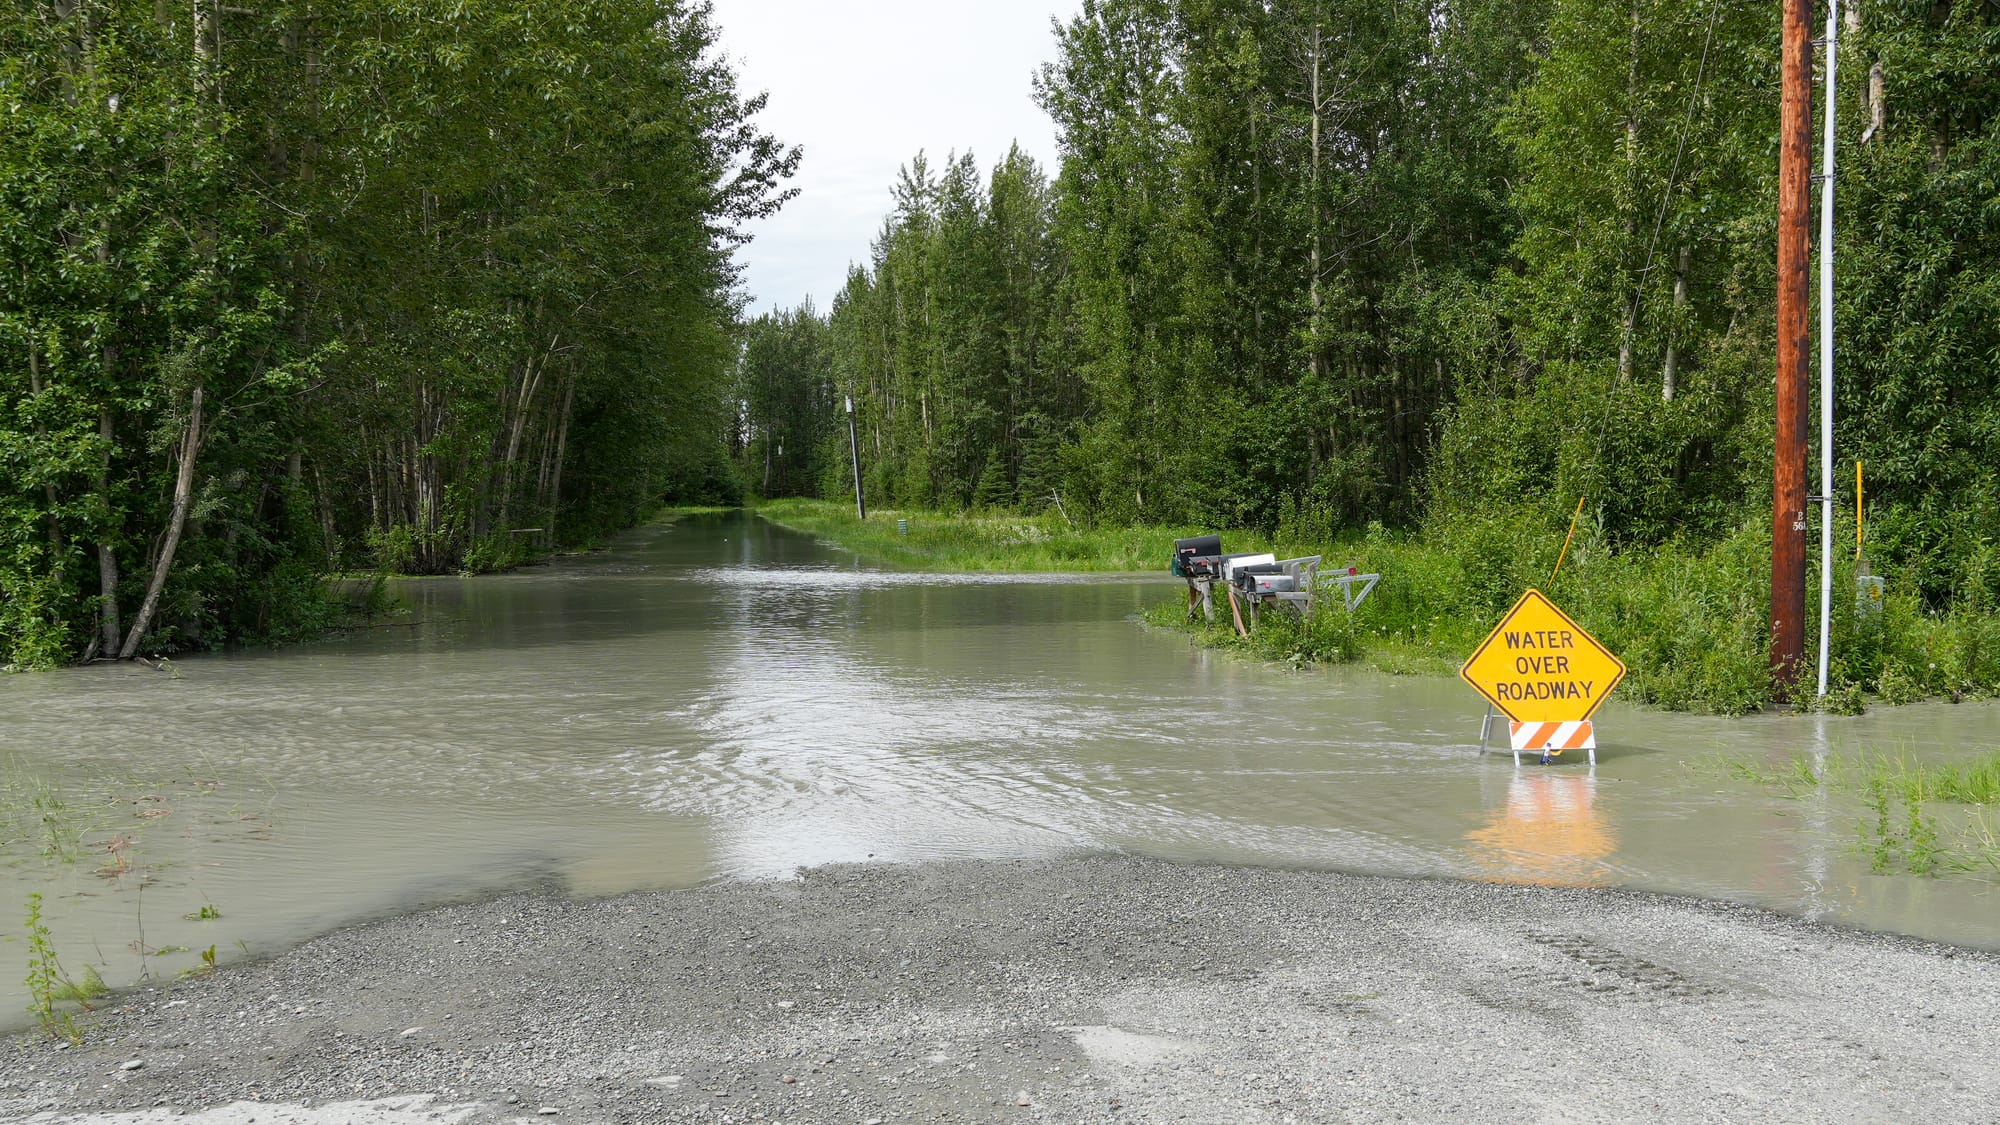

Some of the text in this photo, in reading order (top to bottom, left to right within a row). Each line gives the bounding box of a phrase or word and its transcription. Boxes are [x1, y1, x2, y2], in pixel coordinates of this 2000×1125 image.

[1504, 631, 1574, 649] WATER
[1516, 656, 1570, 675] OVER
[1496, 680, 1593, 701] ROADWAY
